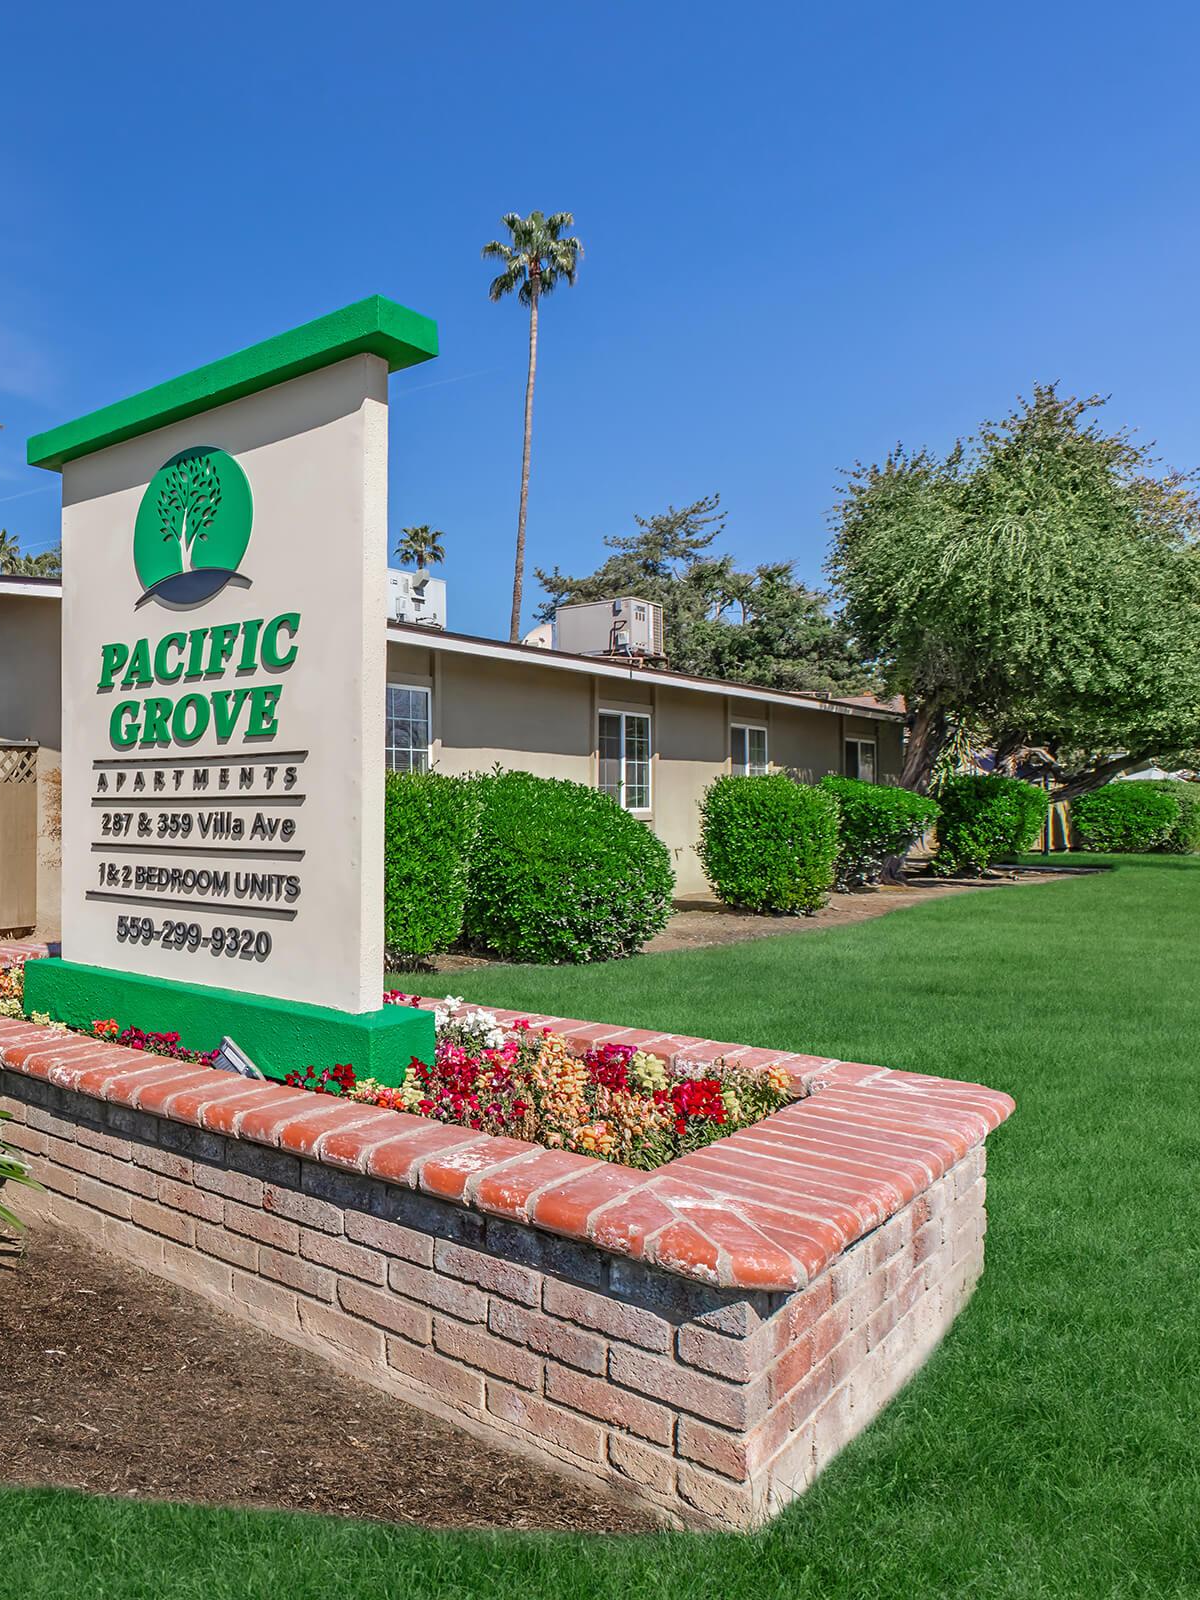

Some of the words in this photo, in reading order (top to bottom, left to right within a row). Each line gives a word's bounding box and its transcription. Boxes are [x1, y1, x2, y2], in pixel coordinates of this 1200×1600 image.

[97, 612, 301, 692] PACIFIC
[109, 684, 283, 749] GROVE
[97, 767, 297, 791] APARTMENTS
[101, 812, 134, 836] 287
[137, 812, 153, 837] &
[157, 812, 193, 838] 359
[198, 811, 245, 839] Villa
[250, 812, 296, 841] Ave
[134, 865, 230, 897] BEDROOM
[235, 872, 301, 902] UNITS
[117, 915, 272, 961] 559-299-9320
